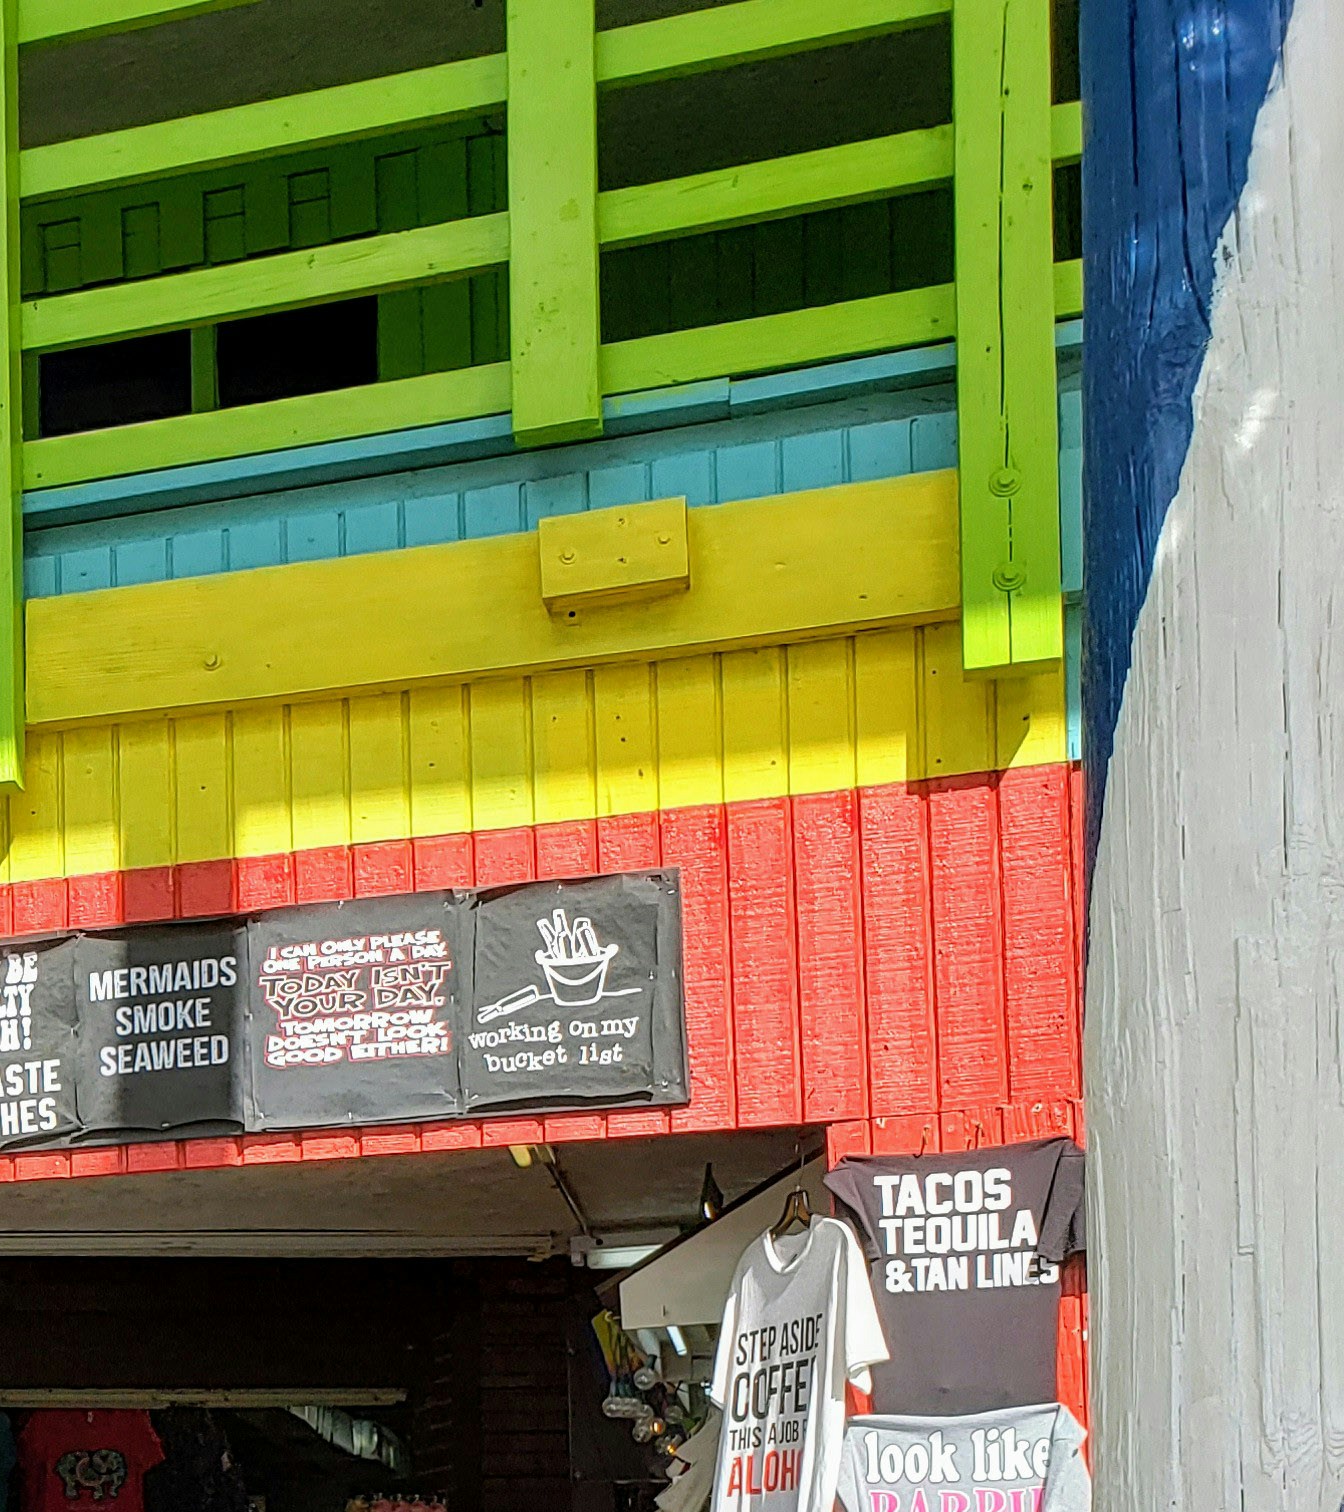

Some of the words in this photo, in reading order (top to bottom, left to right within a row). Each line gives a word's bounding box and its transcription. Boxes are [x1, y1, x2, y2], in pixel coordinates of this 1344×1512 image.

[263, 959, 301, 974] ONE
[308, 950, 382, 969] PERSON
[280, 943, 317, 959] CAN
[320, 938, 366, 956] ONLY
[370, 930, 440, 949] PLEASE
[5, 951, 38, 985] BE
[89, 955, 237, 1003] MERMAIDS
[259, 967, 360, 999] TODAY
[371, 961, 451, 988] ISN'T
[115, 997, 212, 1037] SMOKE
[268, 992, 366, 1020] YOUR
[374, 982, 445, 1009] DAY.
[267, 1030, 367, 1052] DOESN'T
[377, 1021, 447, 1042] LOOK
[280, 1009, 433, 1036] TOMORROW
[468, 1020, 562, 1049] working
[600, 1016, 639, 1038] my
[99, 1033, 229, 1078] SEAWEED
[267, 1047, 343, 1067] GOOD
[351, 1036, 449, 1059] EITHER!
[483, 1045, 568, 1072] bucket
[578, 1043, 623, 1065] list
[874, 1168, 1012, 1217] TACOS
[878, 1209, 1038, 1255] TEQUILA
[976, 1250, 1060, 1289] LINES
[736, 1325, 777, 1366] STEP
[779, 1313, 823, 1358] ASIDE
[729, 1426, 762, 1451] THIS
[767, 1423, 776, 1445] A
[779, 1420, 799, 1444] JOB
[865, 1430, 961, 1484] look
[970, 1427, 1051, 1482] like
